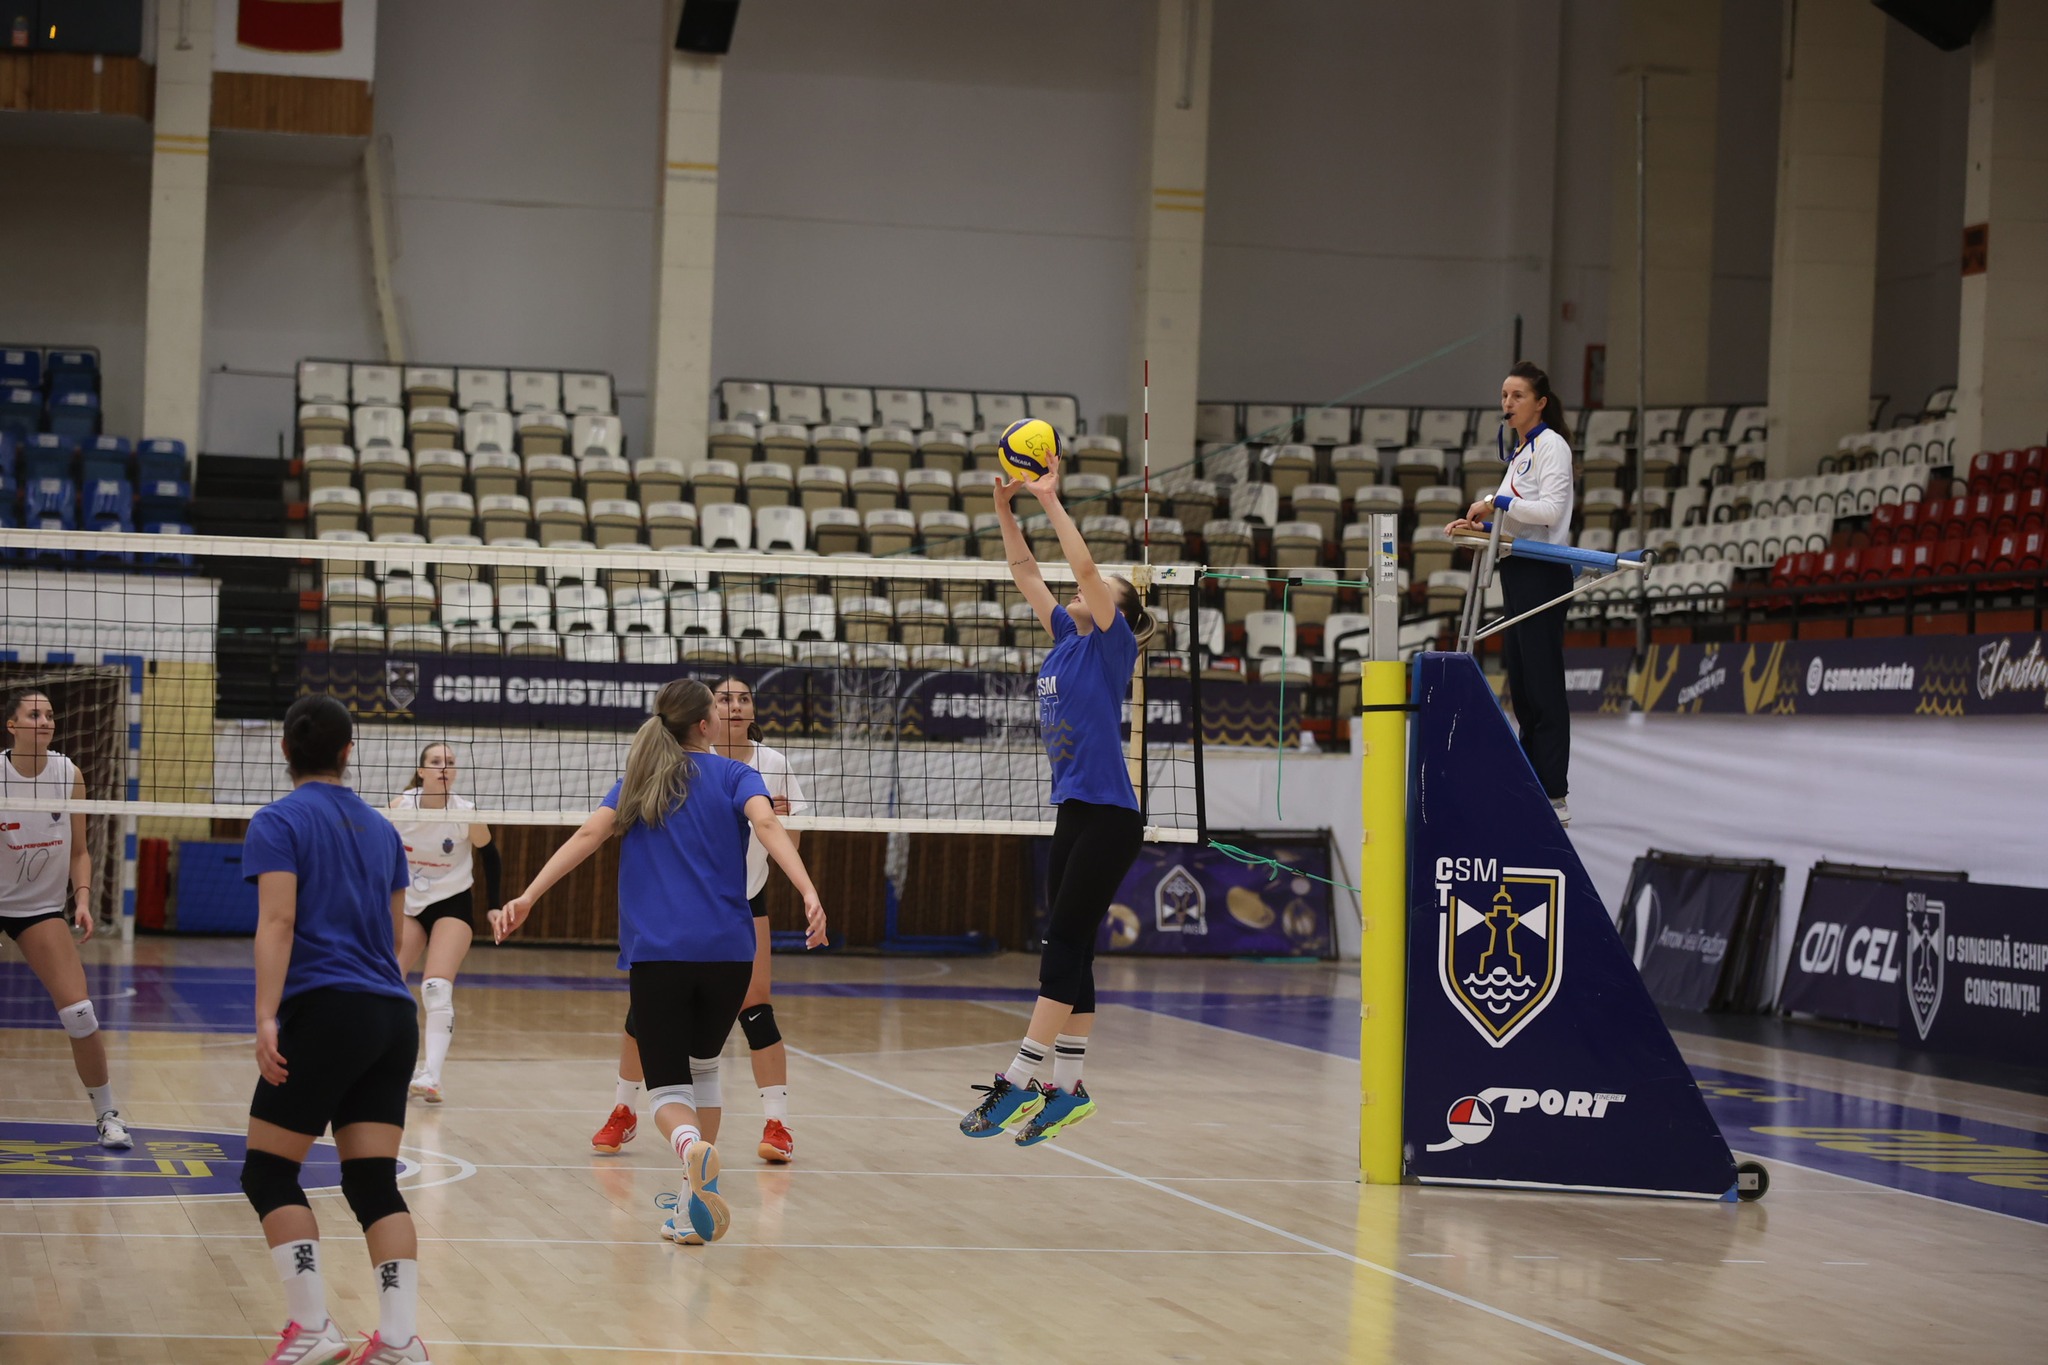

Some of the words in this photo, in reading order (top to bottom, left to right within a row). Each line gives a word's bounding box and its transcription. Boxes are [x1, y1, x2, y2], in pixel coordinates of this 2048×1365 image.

[433, 674, 501, 703] CSM
[16, 848, 50, 884] 10
[1436, 857, 1497, 882] CSM
[1845, 926, 1901, 983] CEL
[1947, 935, 1957, 962] O
[1957, 934, 2013, 968] SINGURĂ
[1964, 977, 2041, 1016] CONSTANȚA!
